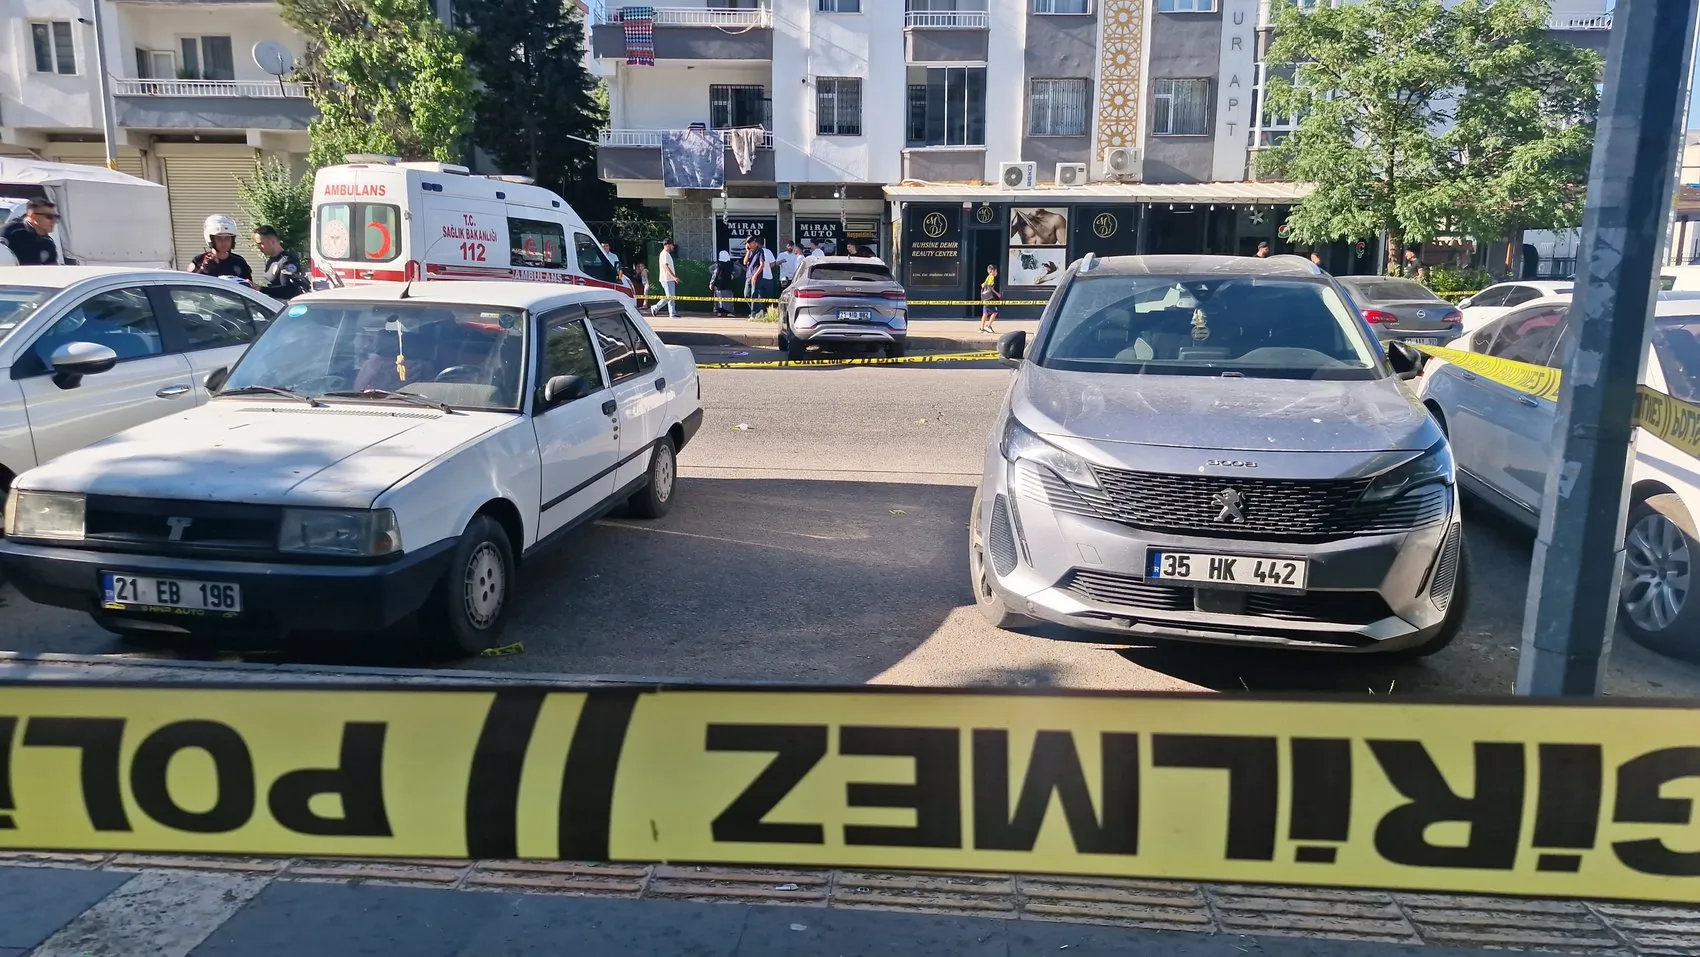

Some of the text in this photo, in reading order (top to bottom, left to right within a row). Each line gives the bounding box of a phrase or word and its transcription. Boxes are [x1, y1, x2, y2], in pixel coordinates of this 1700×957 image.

[1226, 74, 1240, 137] APT
[324, 183, 386, 197] AMBULANS
[463, 214, 476, 227] T.C.
[442, 224, 498, 242] SAĞLIK BAKANLIĞI
[460, 242, 486, 262] 112
[514, 269, 563, 283] AMBULANS
[1207, 459, 1258, 468] 3008
[1163, 554, 1191, 578] 35
[1208, 557, 1238, 581] HK
[1253, 560, 1297, 585] 442
[115, 577, 138, 601] 21
[156, 580, 181, 604] EB
[199, 583, 235, 609] 196
[0, 716, 394, 838] POL
